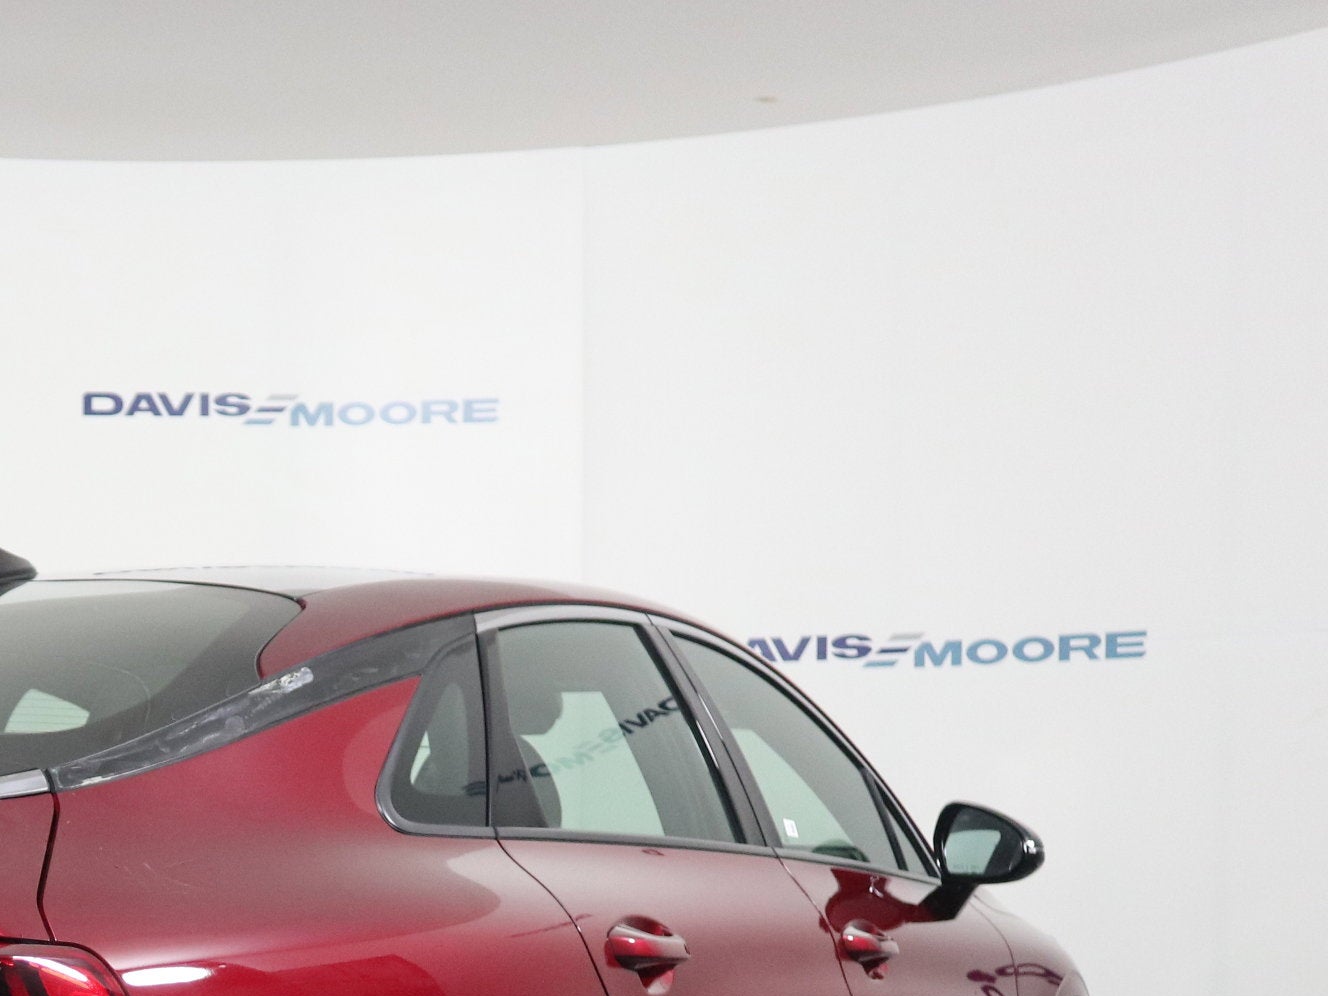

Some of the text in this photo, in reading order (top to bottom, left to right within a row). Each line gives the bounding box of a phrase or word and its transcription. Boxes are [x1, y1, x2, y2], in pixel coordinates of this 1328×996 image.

[82, 391, 500, 427] DAVIS MOORE
[747, 630, 1148, 668] AVIS MOORE
